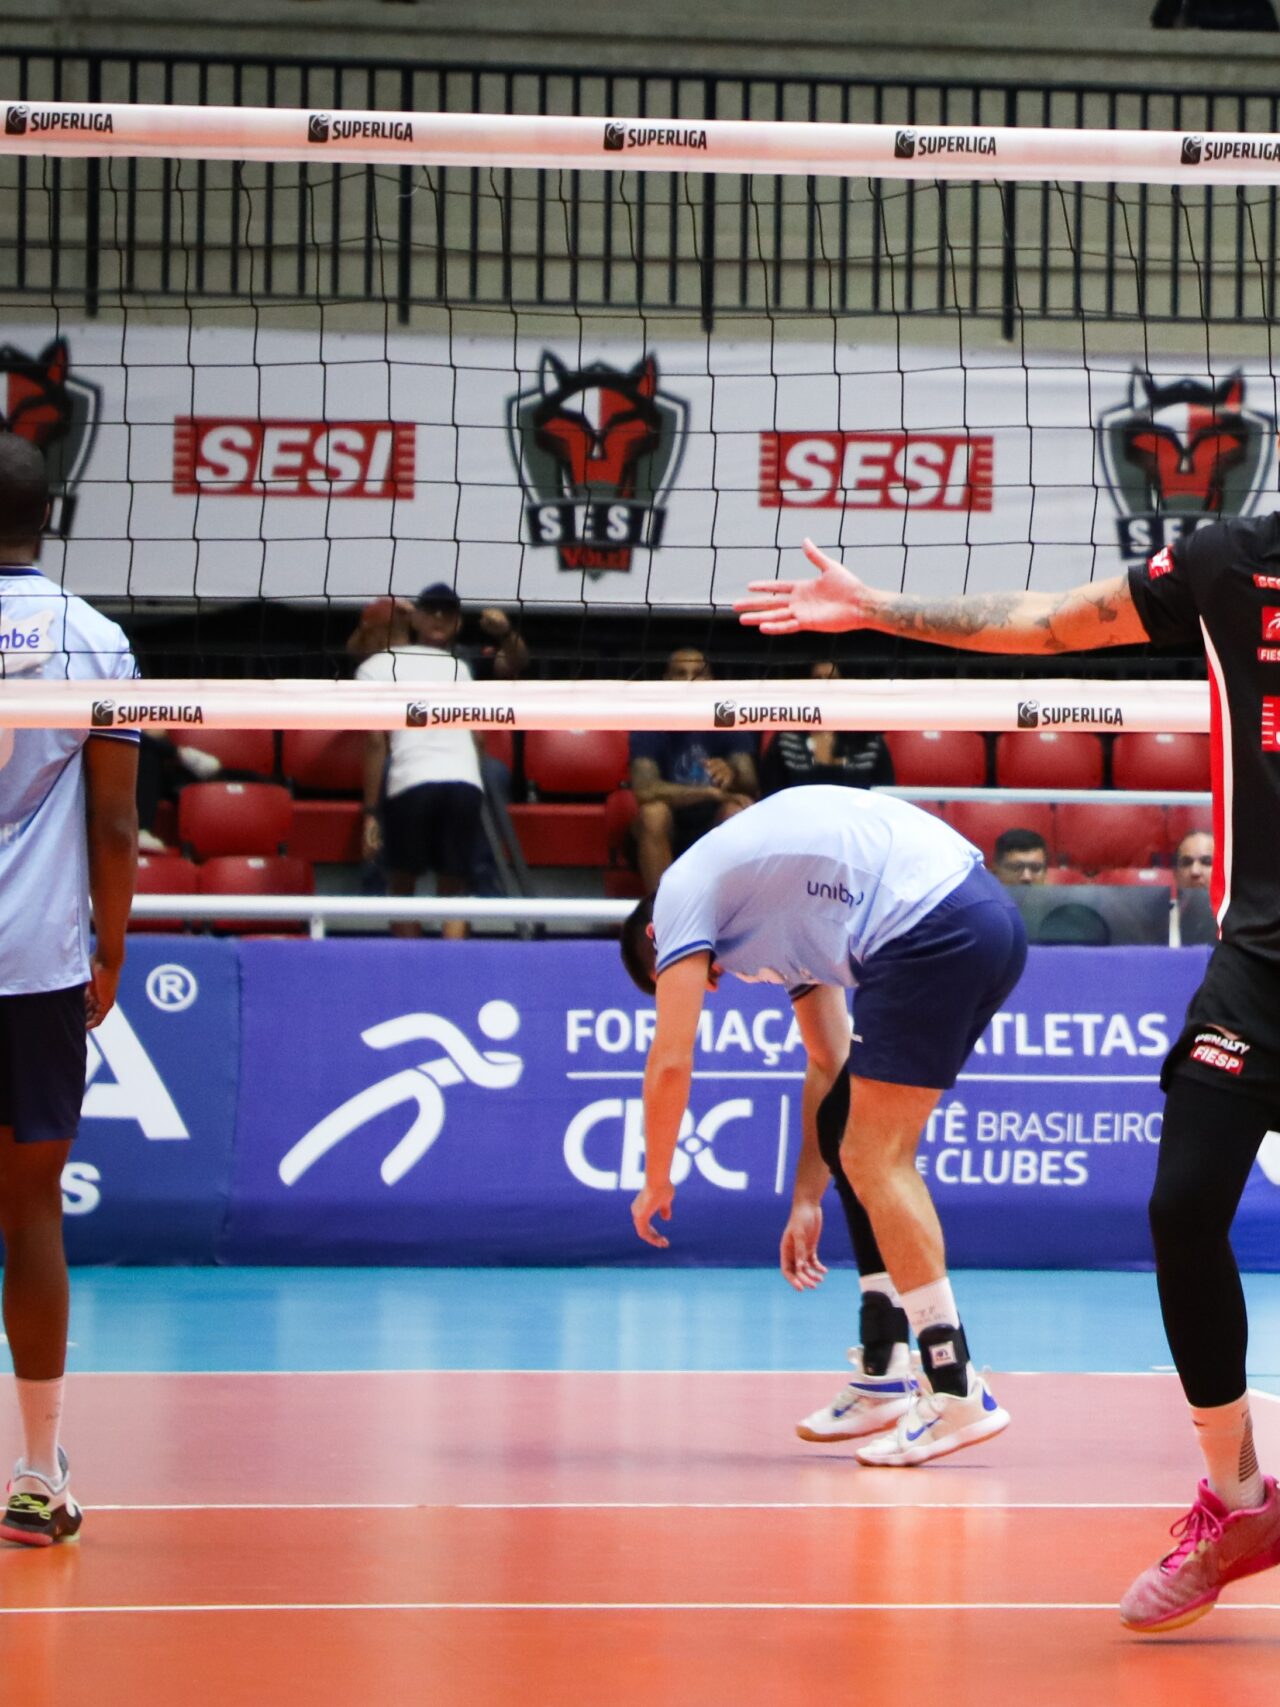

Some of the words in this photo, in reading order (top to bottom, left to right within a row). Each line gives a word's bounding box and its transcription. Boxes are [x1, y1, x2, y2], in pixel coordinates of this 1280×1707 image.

[30, 111, 114, 134] SUPERLIGA
[332, 120, 414, 142] SUPERLIGA
[628, 128, 708, 150] SUPERLIGA
[918, 135, 997, 155] SUPERLIGA
[197, 425, 395, 493] SESI
[780, 438, 974, 507] SESI
[538, 505, 654, 543] SESI
[117, 706, 203, 725] SUPERLIGA
[431, 706, 516, 725] SUPERLIGA
[738, 706, 822, 725] SUPERLIGA
[1041, 707, 1124, 727] SUPERLIGA
[975, 1012, 1169, 1057] TLETAS
[1195, 1033, 1251, 1055] PENALTY
[1193, 1046, 1240, 1070] FIESP
[935, 1148, 1089, 1186] CLUBES
